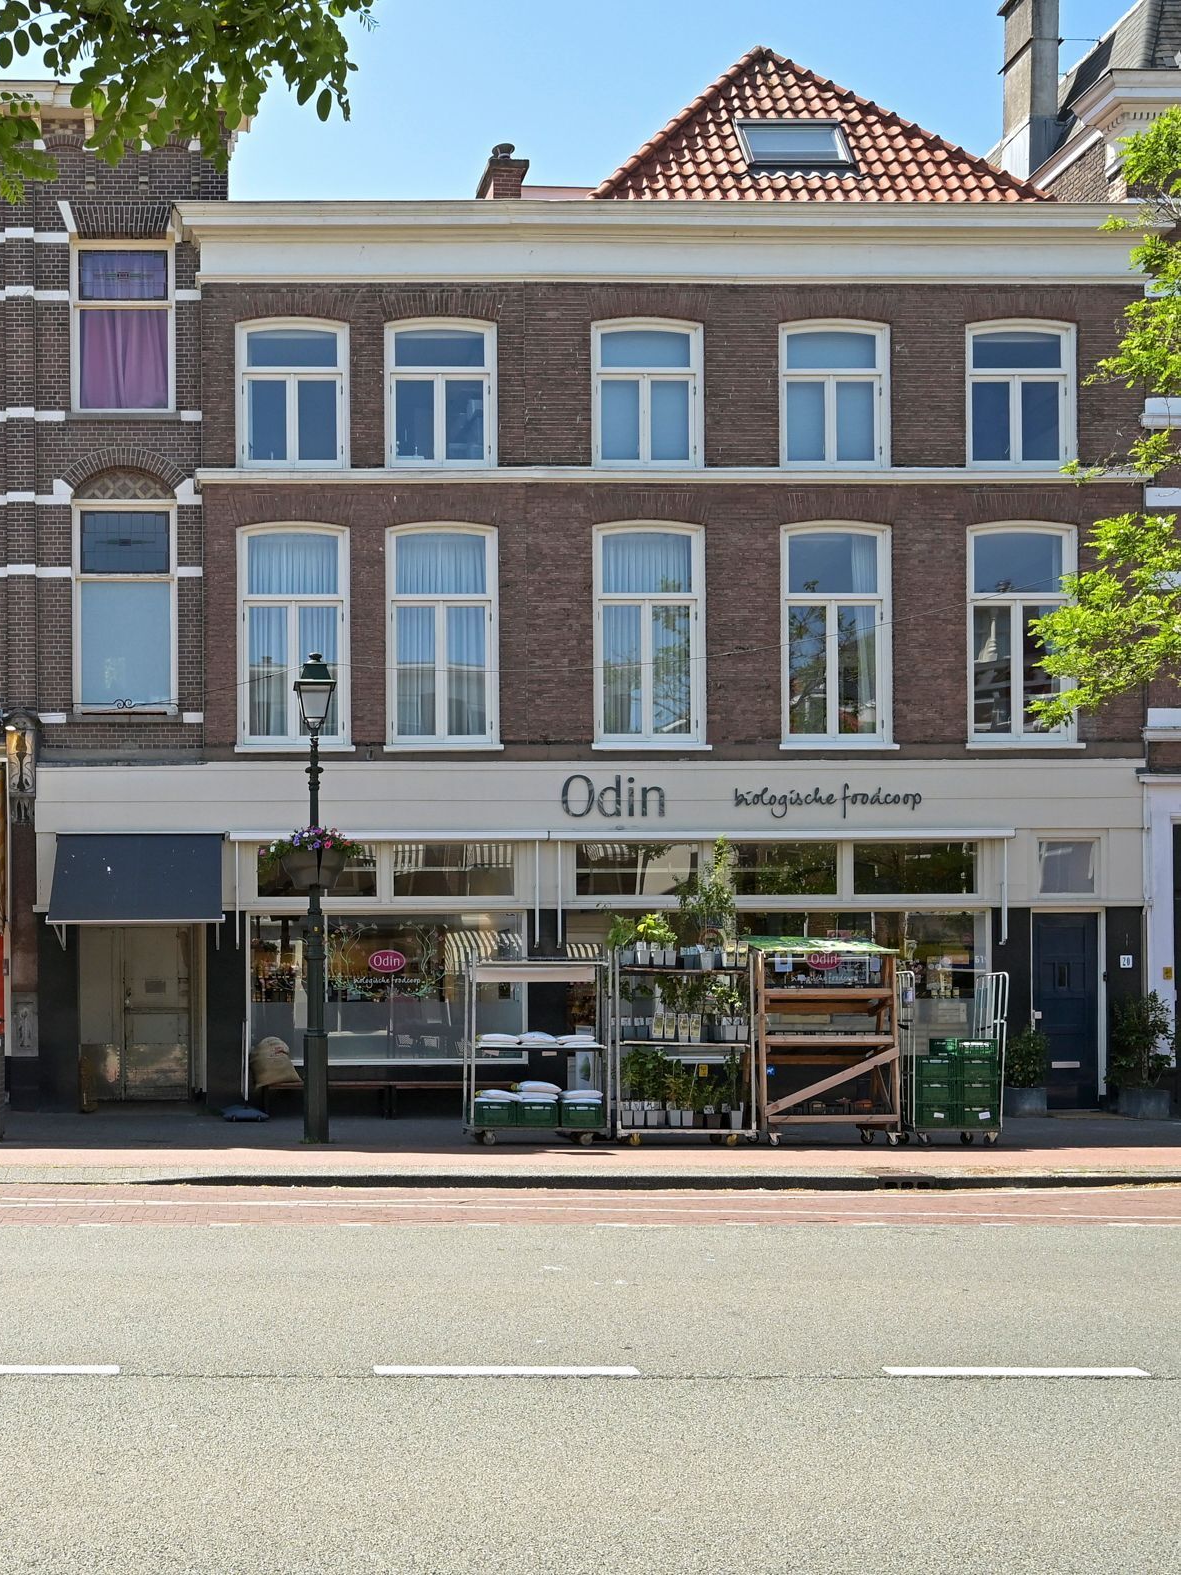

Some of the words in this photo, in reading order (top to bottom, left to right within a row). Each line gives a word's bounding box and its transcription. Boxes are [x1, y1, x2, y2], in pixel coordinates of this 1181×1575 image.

[561, 774, 666, 818] Odin
[734, 787, 837, 818] biologische
[842, 783, 923, 819] foodcoop
[373, 955, 400, 967] Odin
[1122, 957, 1131, 967] 20
